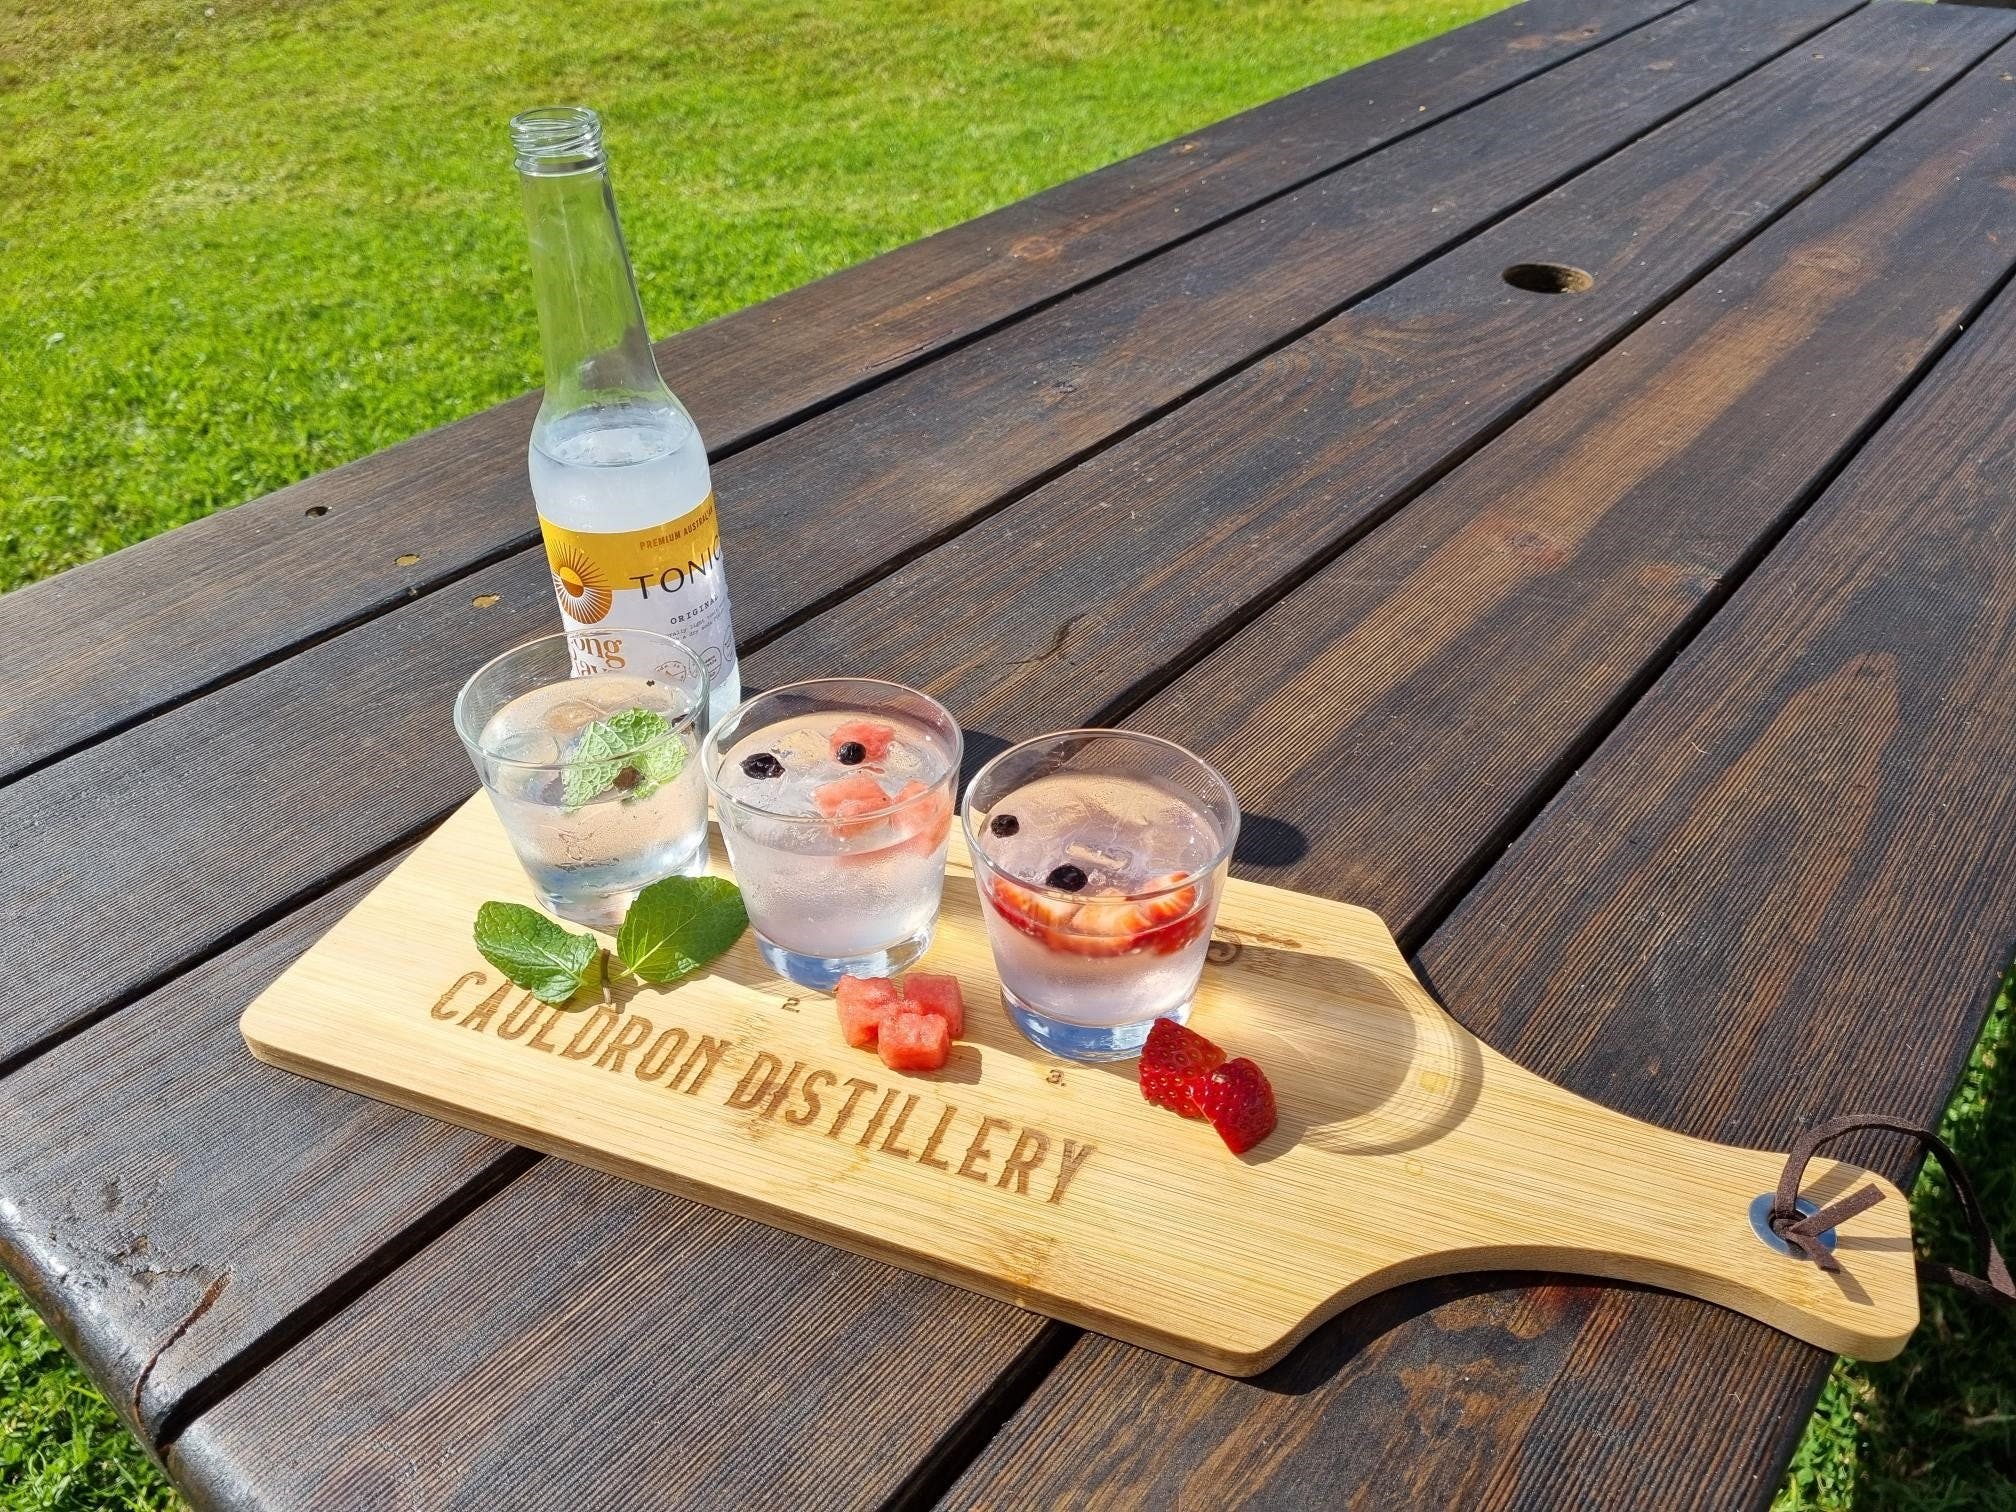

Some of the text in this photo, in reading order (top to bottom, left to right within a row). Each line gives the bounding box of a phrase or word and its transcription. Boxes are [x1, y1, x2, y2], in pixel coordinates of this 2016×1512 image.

[629, 534, 721, 600] TONIC
[639, 530, 681, 551] PREMIUM
[430, 970, 1099, 1206] CAULDRON DISTILLERY
